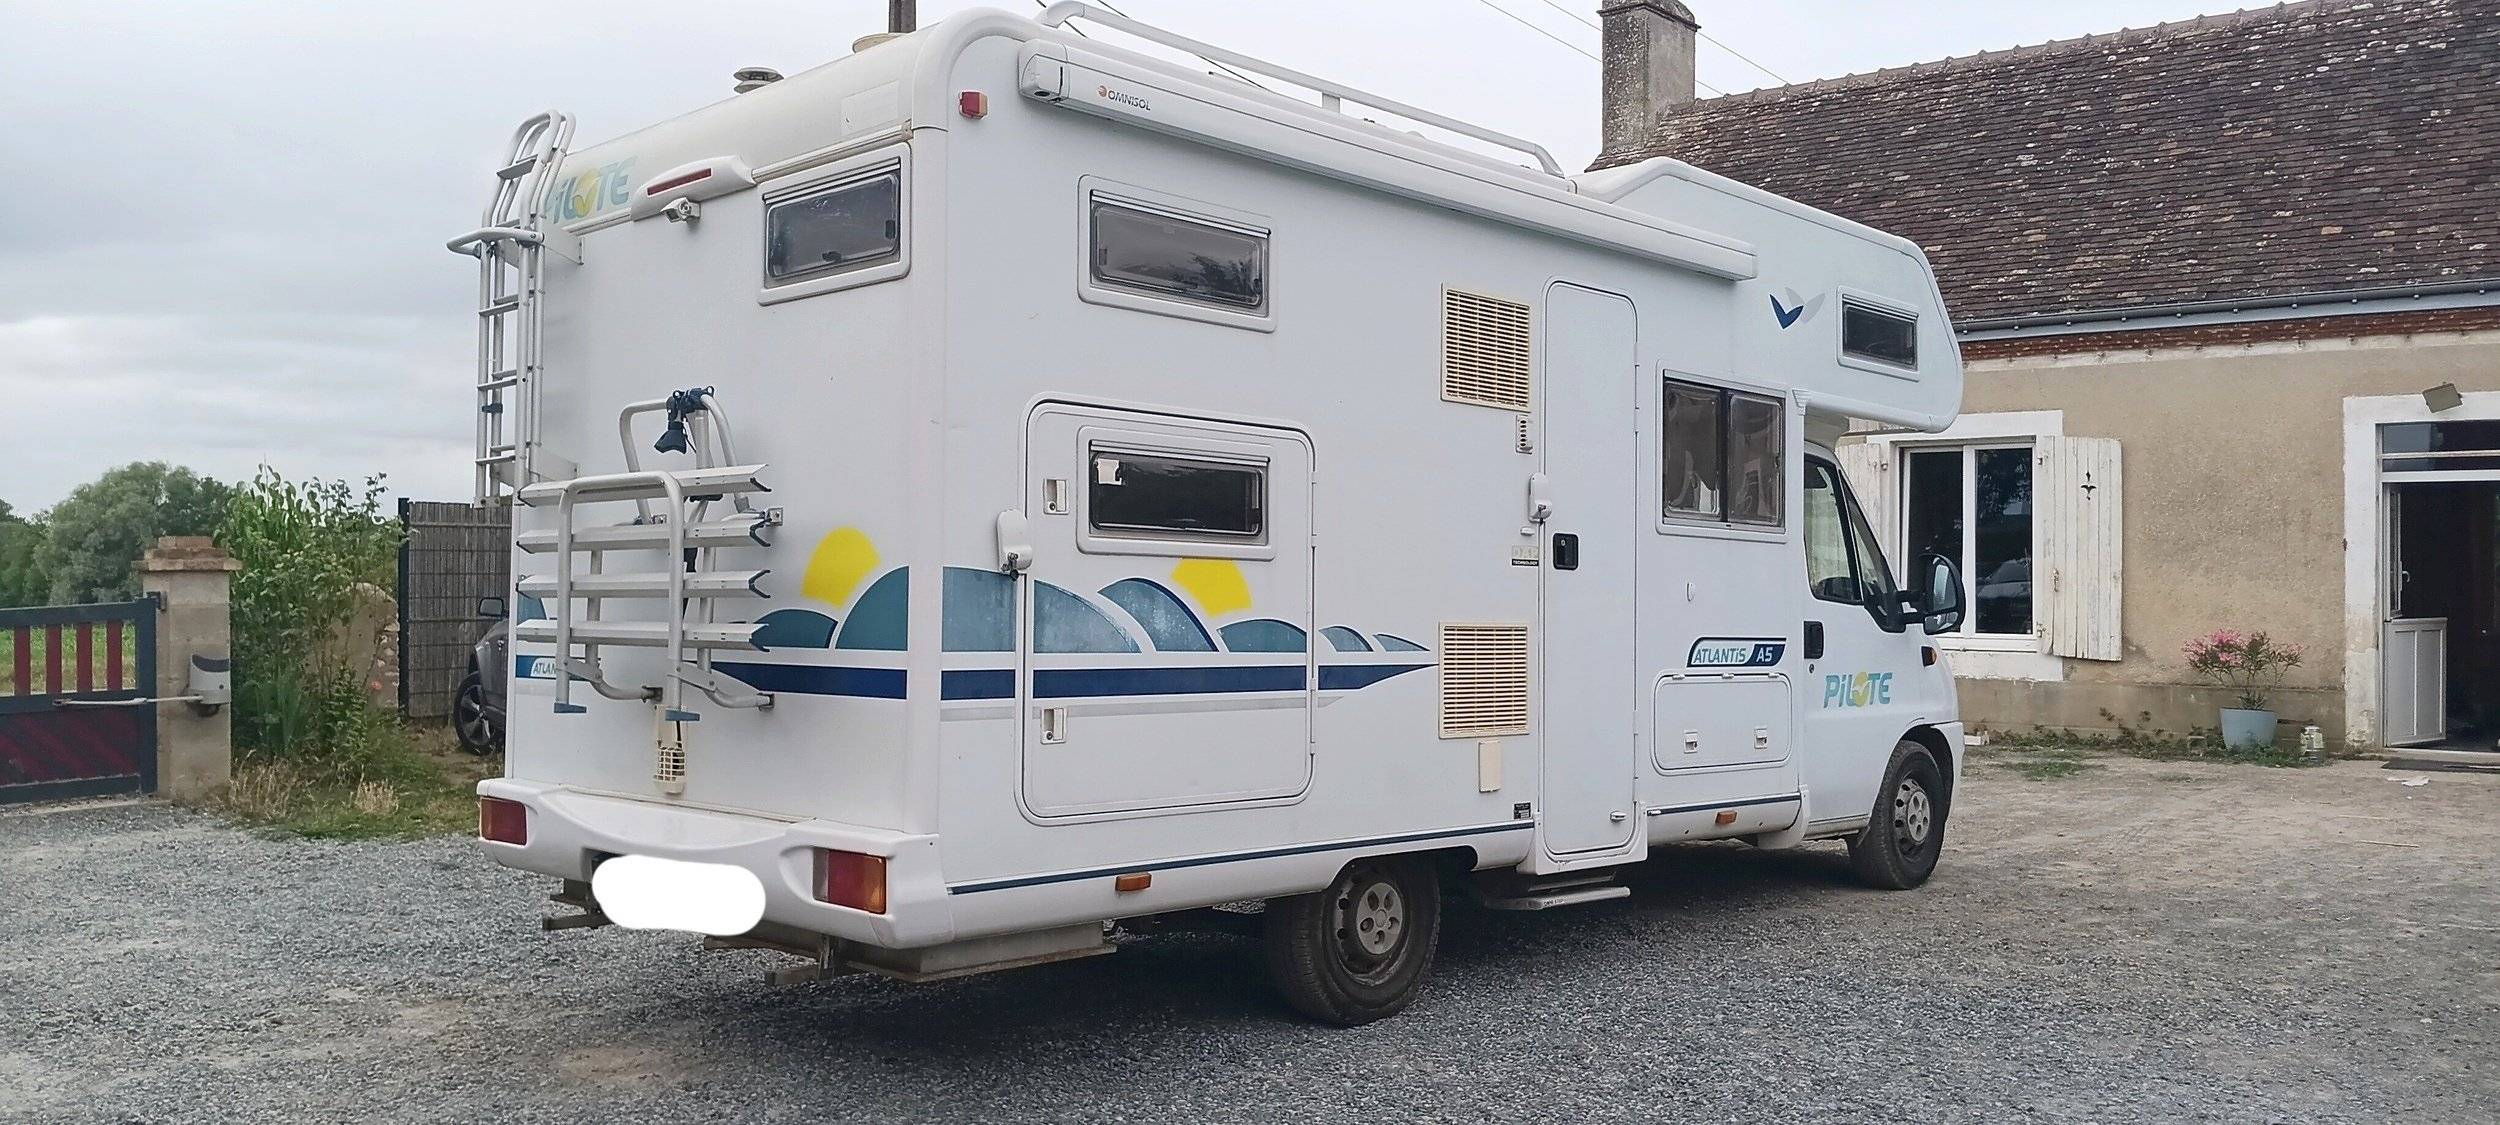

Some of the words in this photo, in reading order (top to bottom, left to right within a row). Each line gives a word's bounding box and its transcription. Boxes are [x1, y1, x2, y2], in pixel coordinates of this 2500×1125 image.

[1107, 90, 1151, 111] OMNISOL
[1755, 646, 1774, 663] A5
[533, 662, 557, 676] ATLAN
